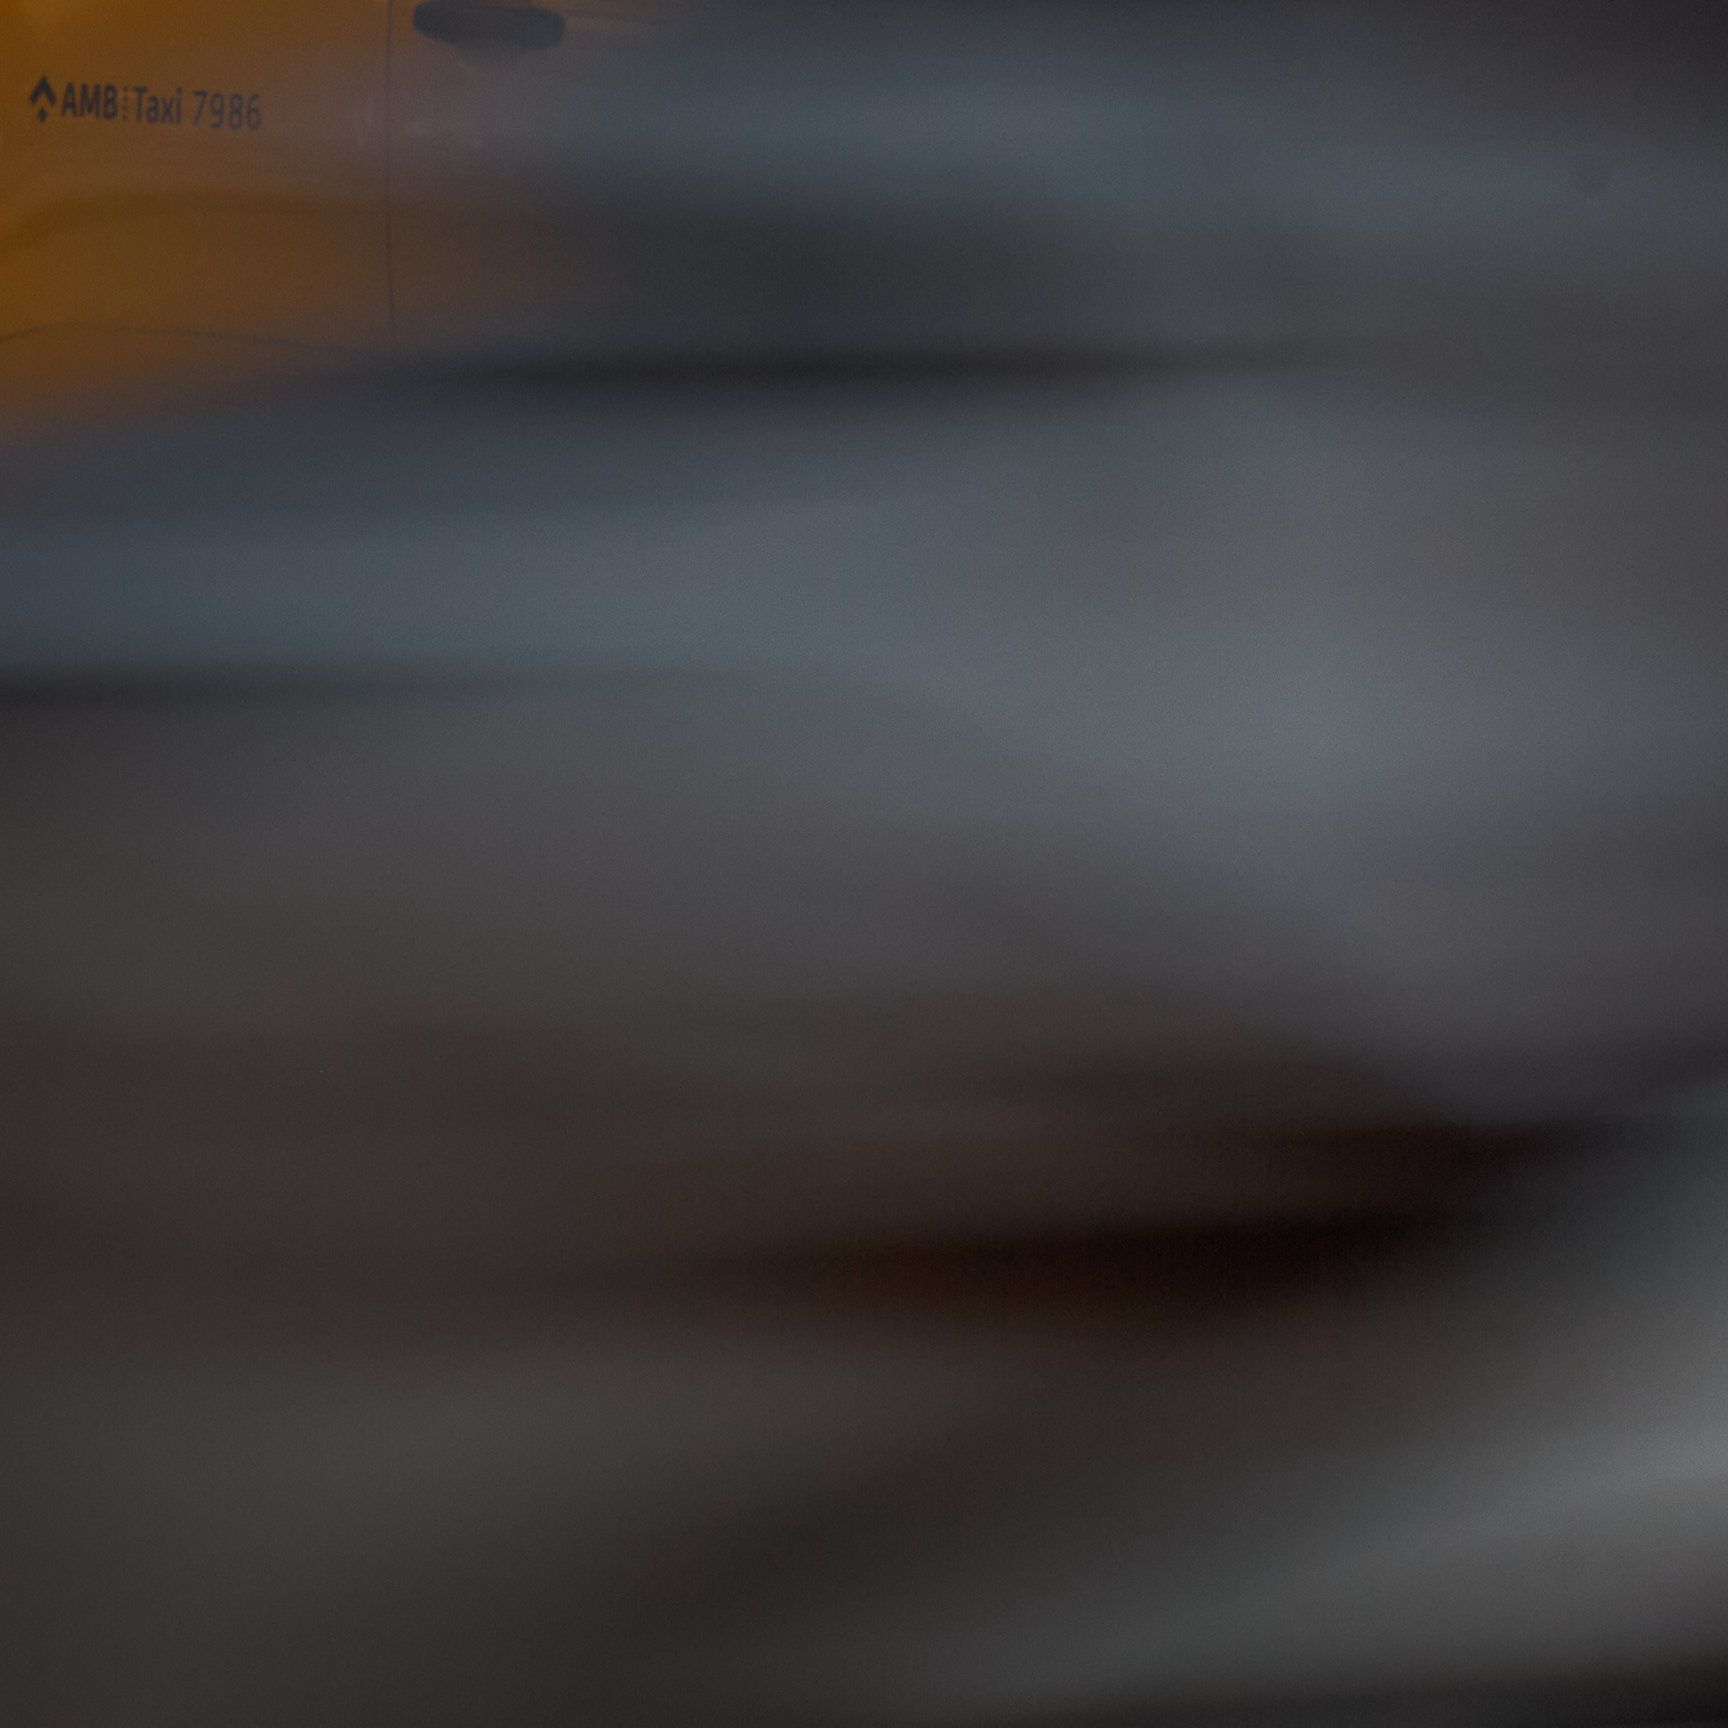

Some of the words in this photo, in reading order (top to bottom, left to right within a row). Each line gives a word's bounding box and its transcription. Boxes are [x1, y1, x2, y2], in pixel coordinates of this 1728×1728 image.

[59, 80, 119, 122] AMB
[131, 84, 184, 126] Taxi
[192, 88, 263, 132] 7986
